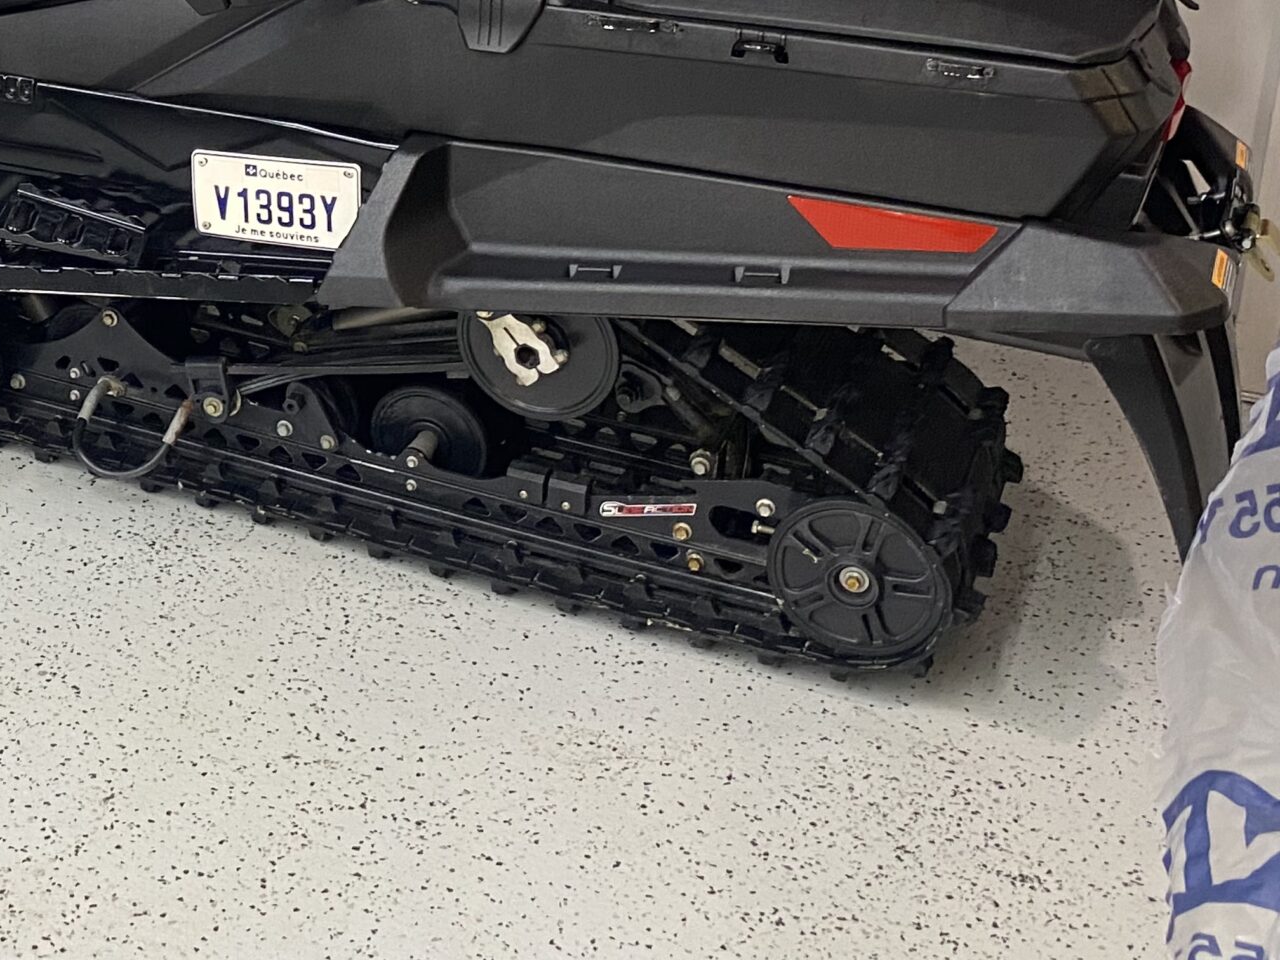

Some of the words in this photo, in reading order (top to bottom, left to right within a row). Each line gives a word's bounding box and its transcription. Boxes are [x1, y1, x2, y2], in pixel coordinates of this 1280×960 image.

[259, 169, 304, 182] Québec
[214, 184, 337, 232] V1393Y
[235, 224, 247, 234] Je
[251, 227, 266, 237] me
[269, 230, 320, 243] souviens
